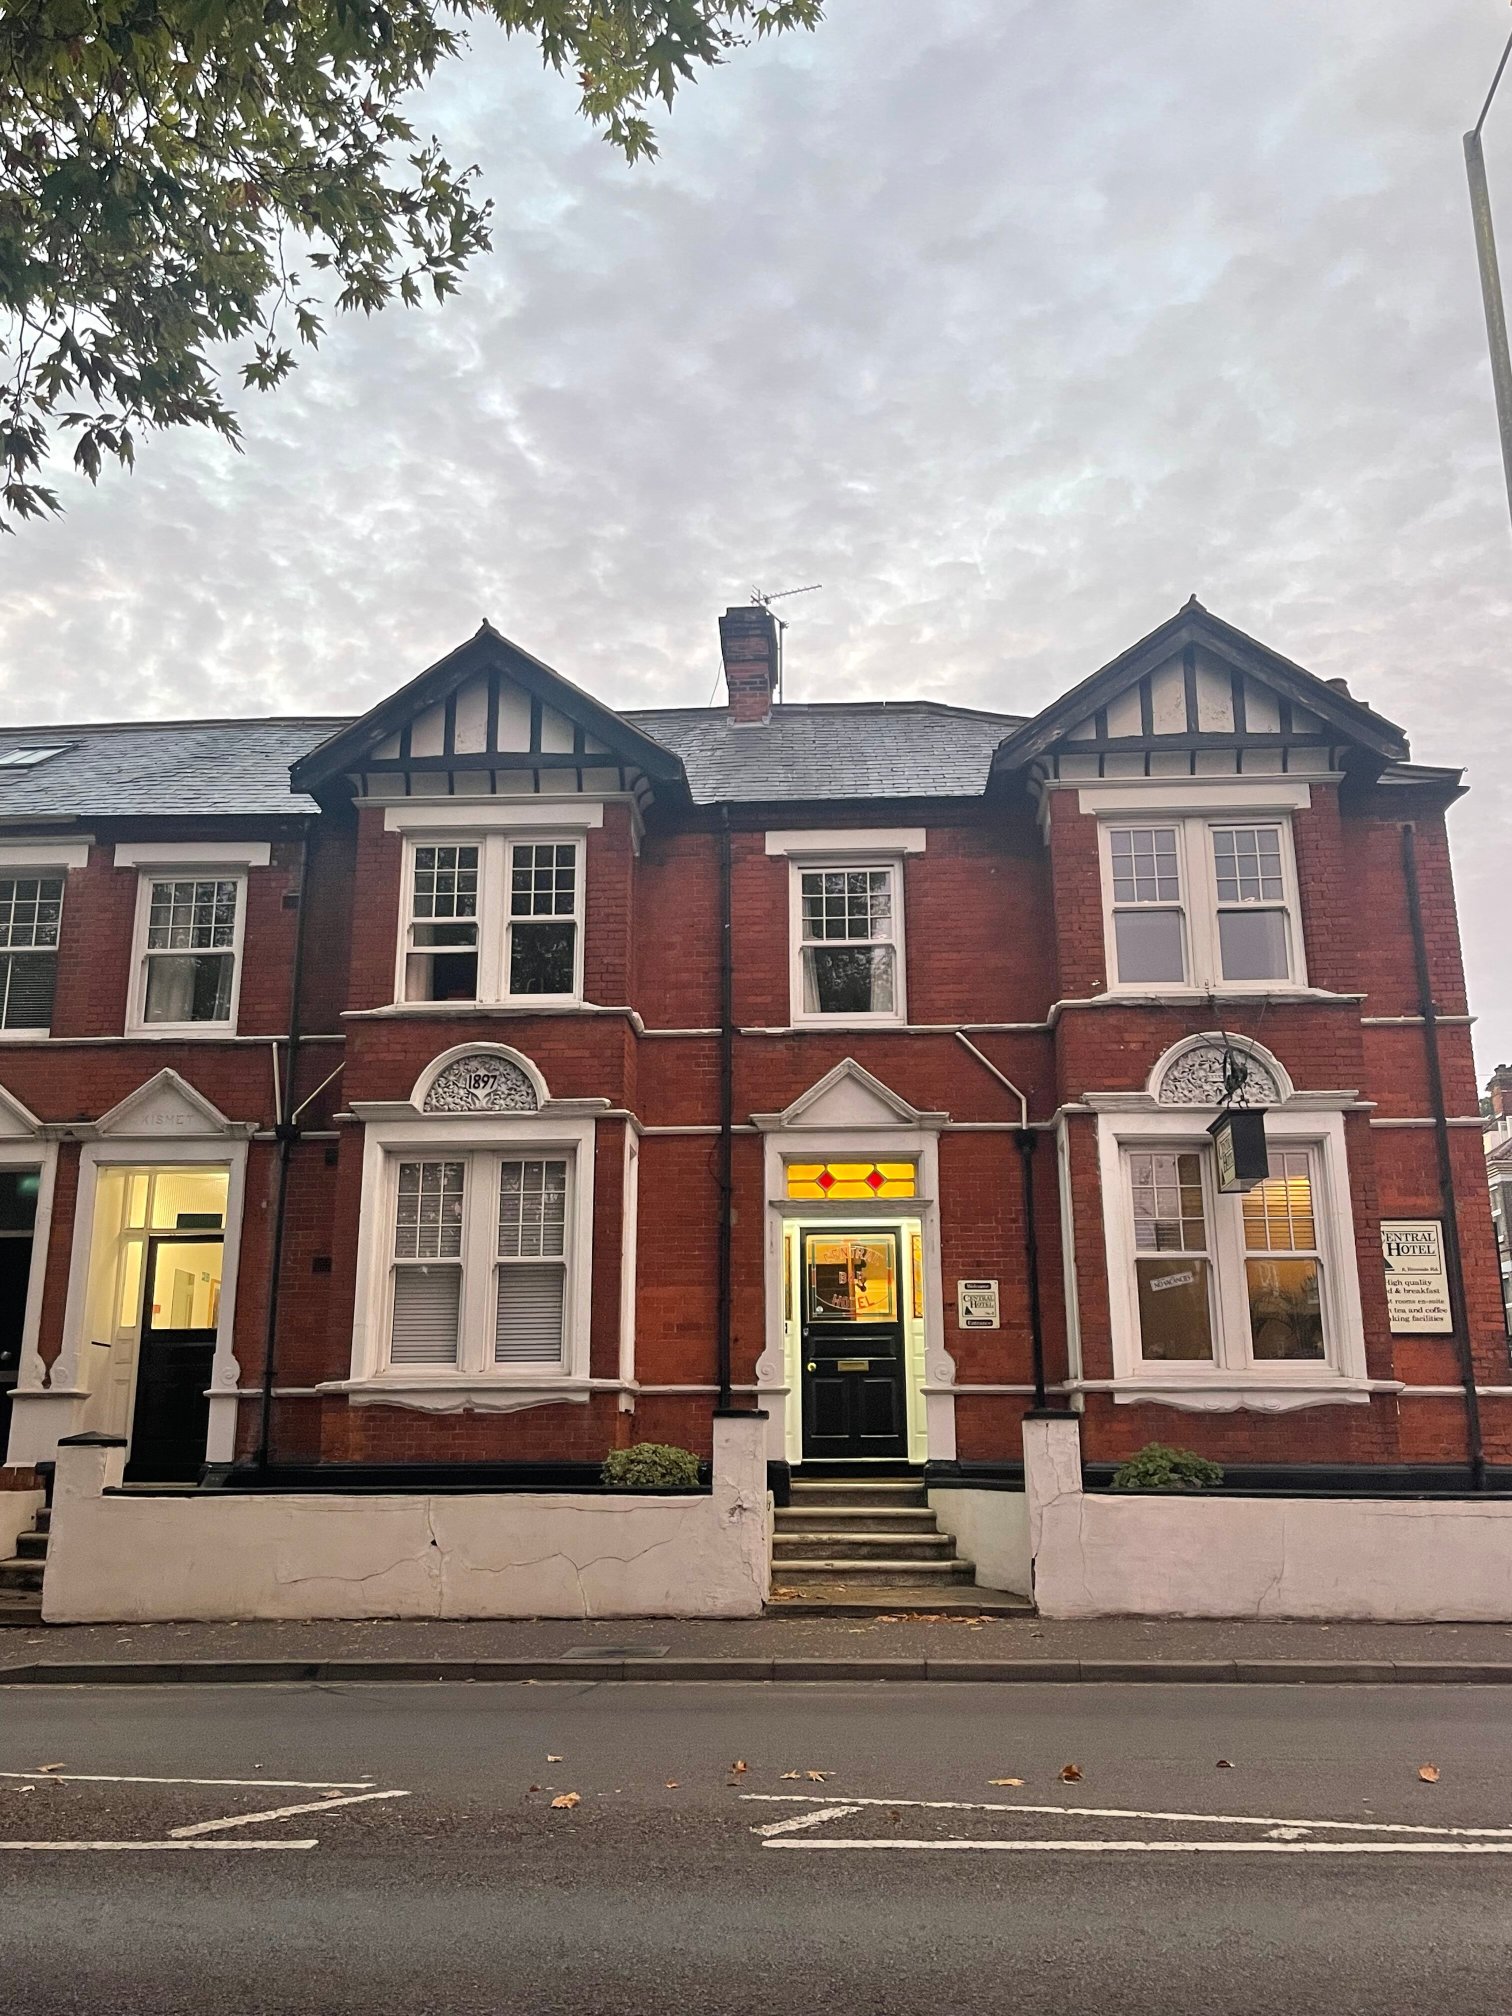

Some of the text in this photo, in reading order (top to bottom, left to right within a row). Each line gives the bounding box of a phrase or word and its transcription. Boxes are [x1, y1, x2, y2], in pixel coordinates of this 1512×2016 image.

[469, 1074, 497, 1089] 1897
[143, 1114, 194, 1125] KISMET
[1381, 1231, 1436, 1243] ENTRAL
[1387, 1242, 1436, 1256] HOTEL
[1405, 1279, 1432, 1287] quality
[831, 1293, 875, 1309] HOTEL
